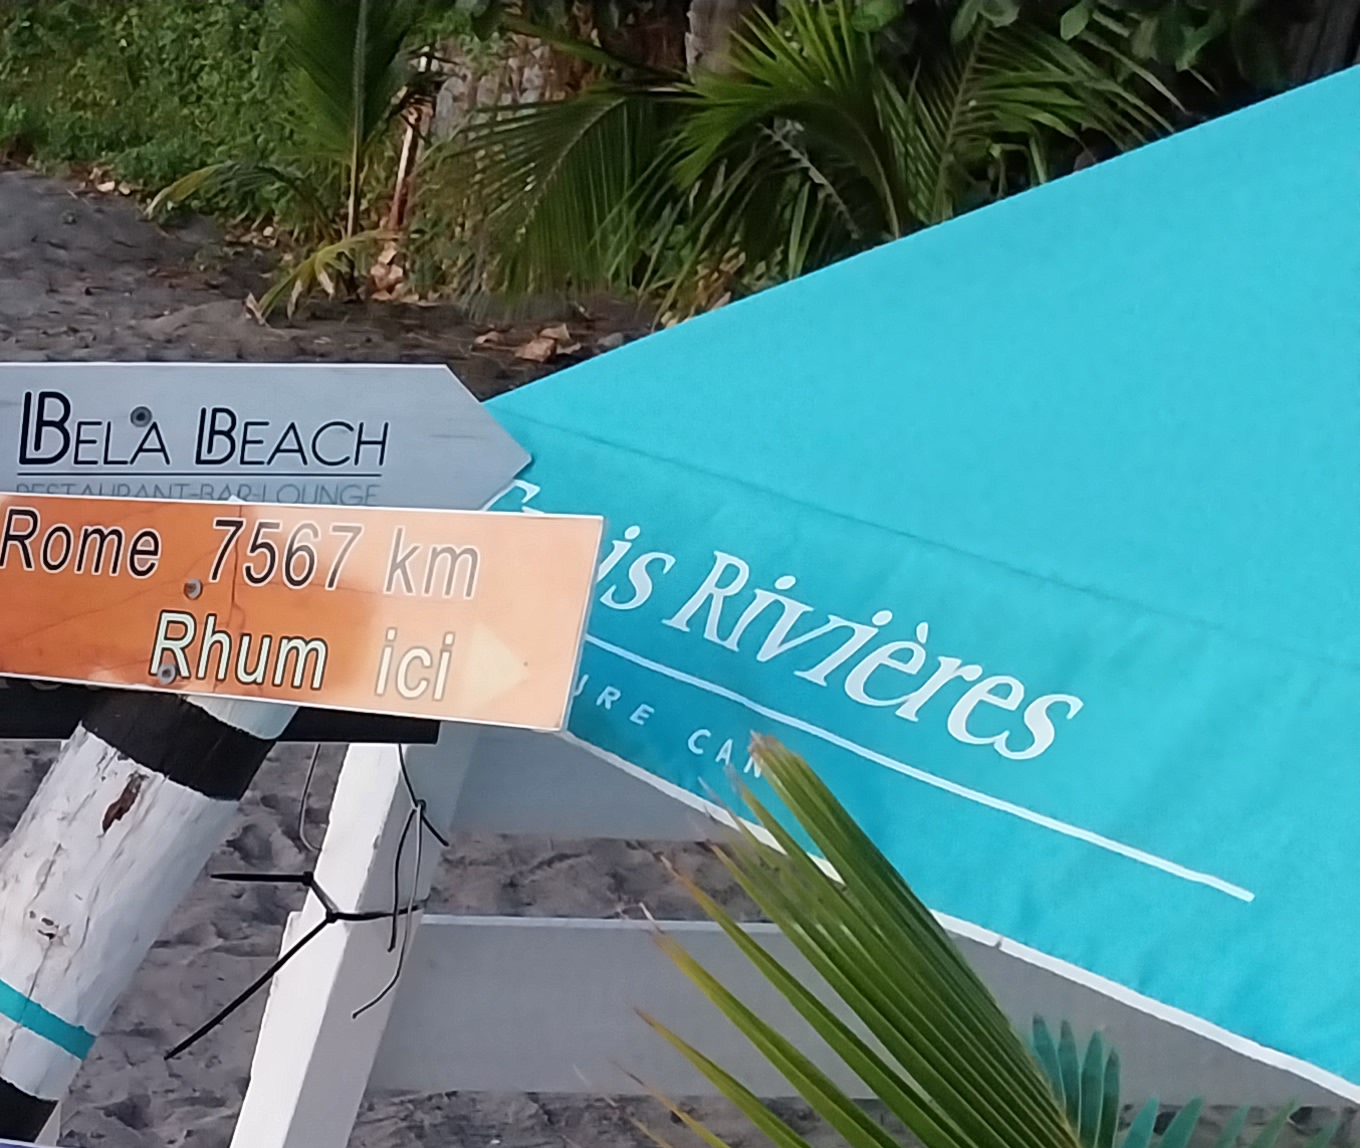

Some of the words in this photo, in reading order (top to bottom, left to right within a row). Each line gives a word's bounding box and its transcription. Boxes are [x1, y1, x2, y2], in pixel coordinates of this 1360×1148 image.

[18, 390, 171, 466] BELA
[194, 406, 390, 466] BEACH
[208, 516, 364, 590] 7567
[382, 526, 479, 600] km
[149, 610, 329, 690] Rhum
[375, 627, 456, 702] ici
[662, 550, 1083, 761] Rivières
